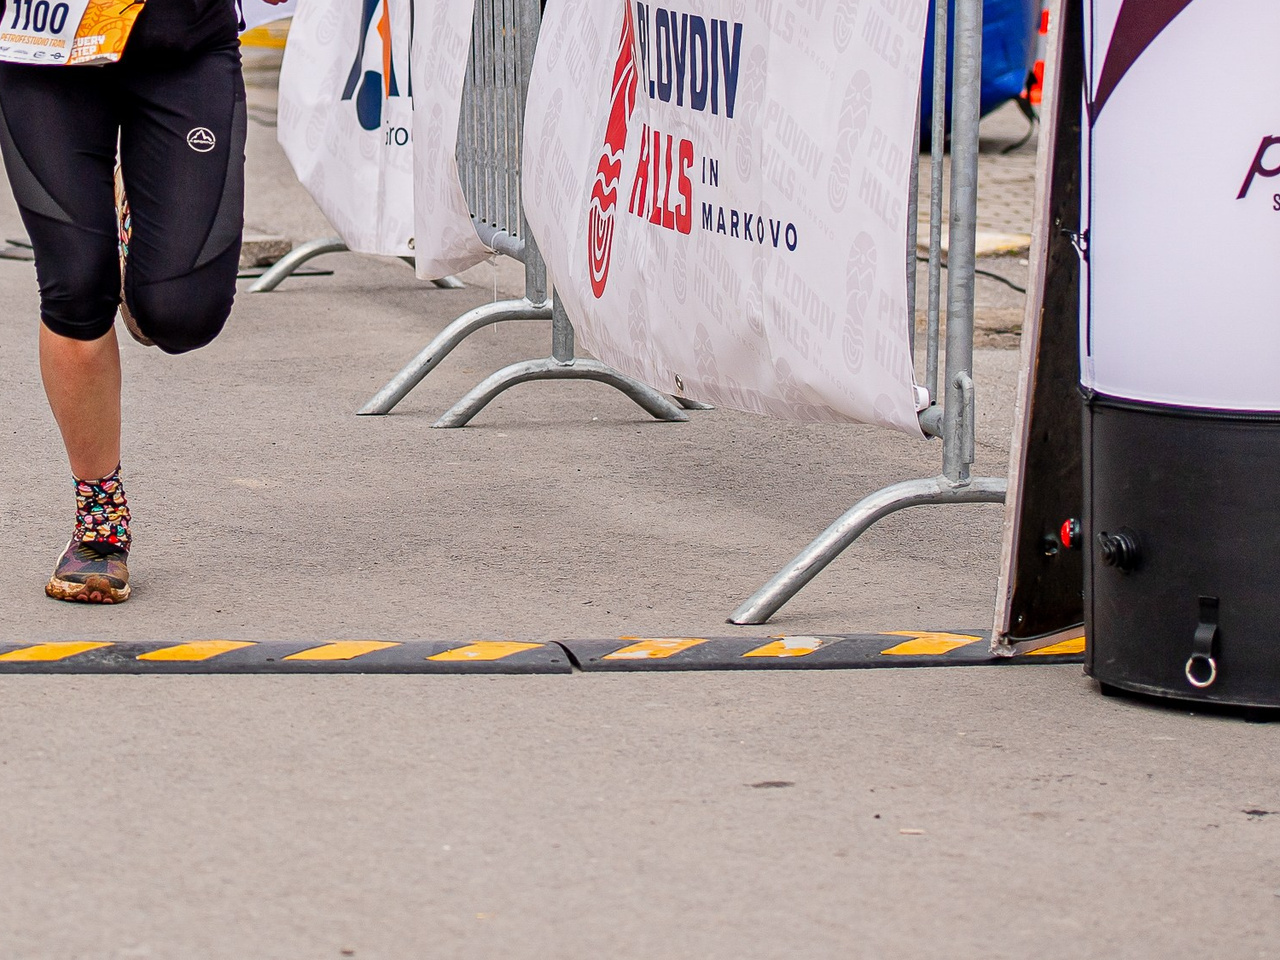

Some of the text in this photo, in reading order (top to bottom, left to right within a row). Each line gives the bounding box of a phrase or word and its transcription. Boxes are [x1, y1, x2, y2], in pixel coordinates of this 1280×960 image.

[628, 123, 694, 236] HLLS
[702, 156, 719, 188] IN
[701, 201, 799, 252] MARKOVO
